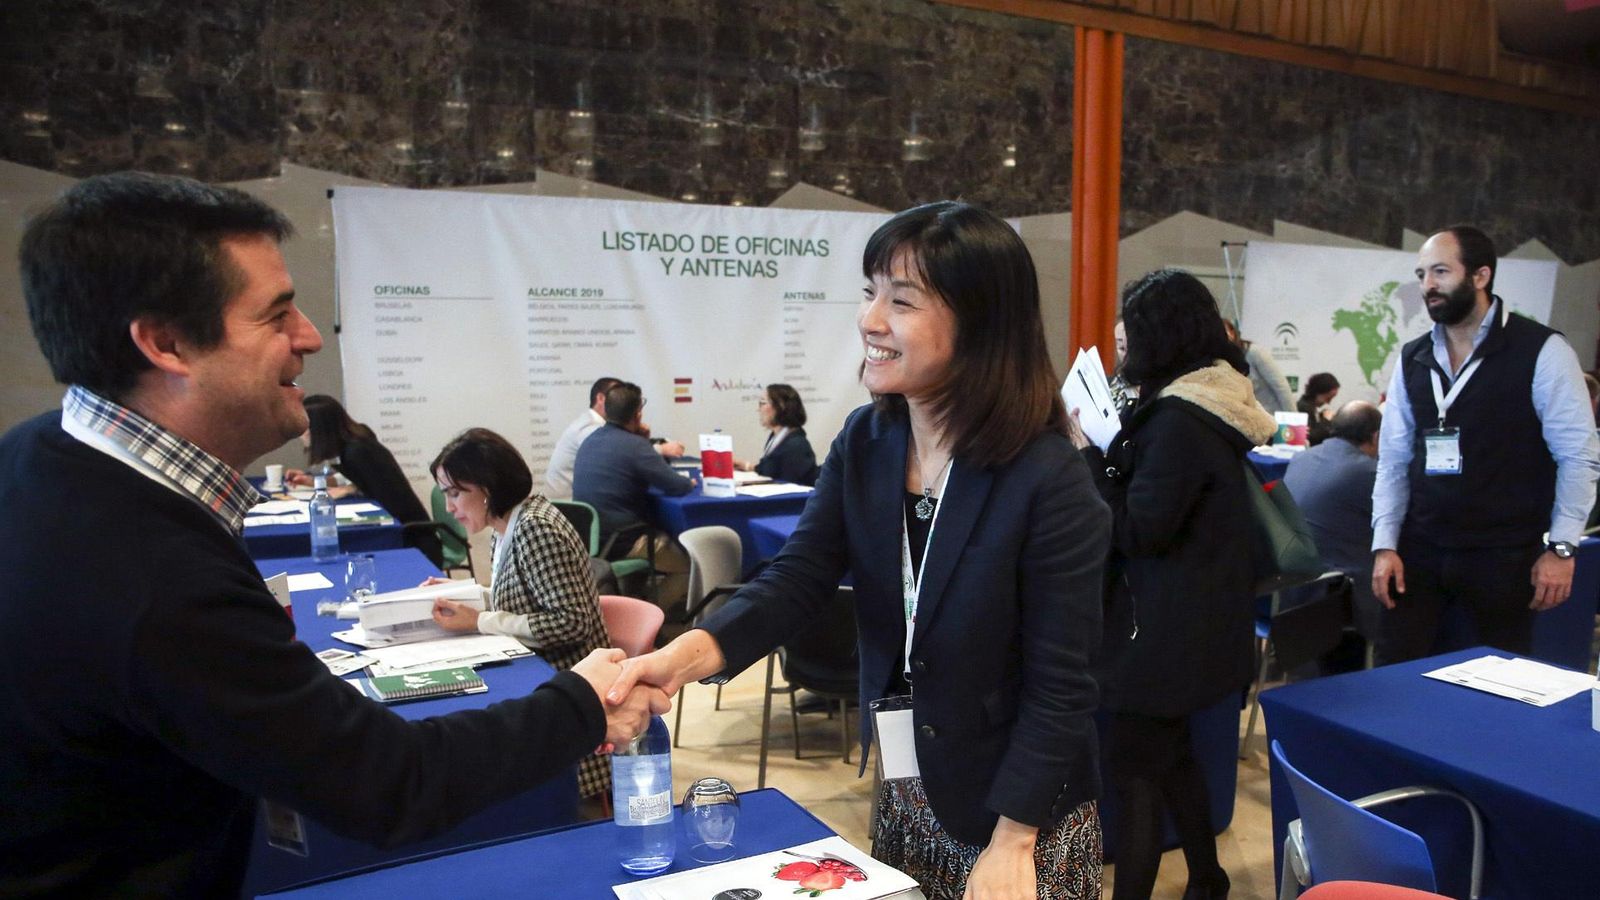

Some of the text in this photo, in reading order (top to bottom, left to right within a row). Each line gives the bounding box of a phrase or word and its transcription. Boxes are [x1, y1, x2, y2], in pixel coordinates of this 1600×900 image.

[602, 231, 830, 257] LISTADO DE OFICINAS
[660, 257, 778, 278] Y ANTENAS
[374, 285, 430, 296] OFICINAS
[528, 287, 604, 298] ALCANCE 2019
[784, 292, 826, 301] ANTENAS
